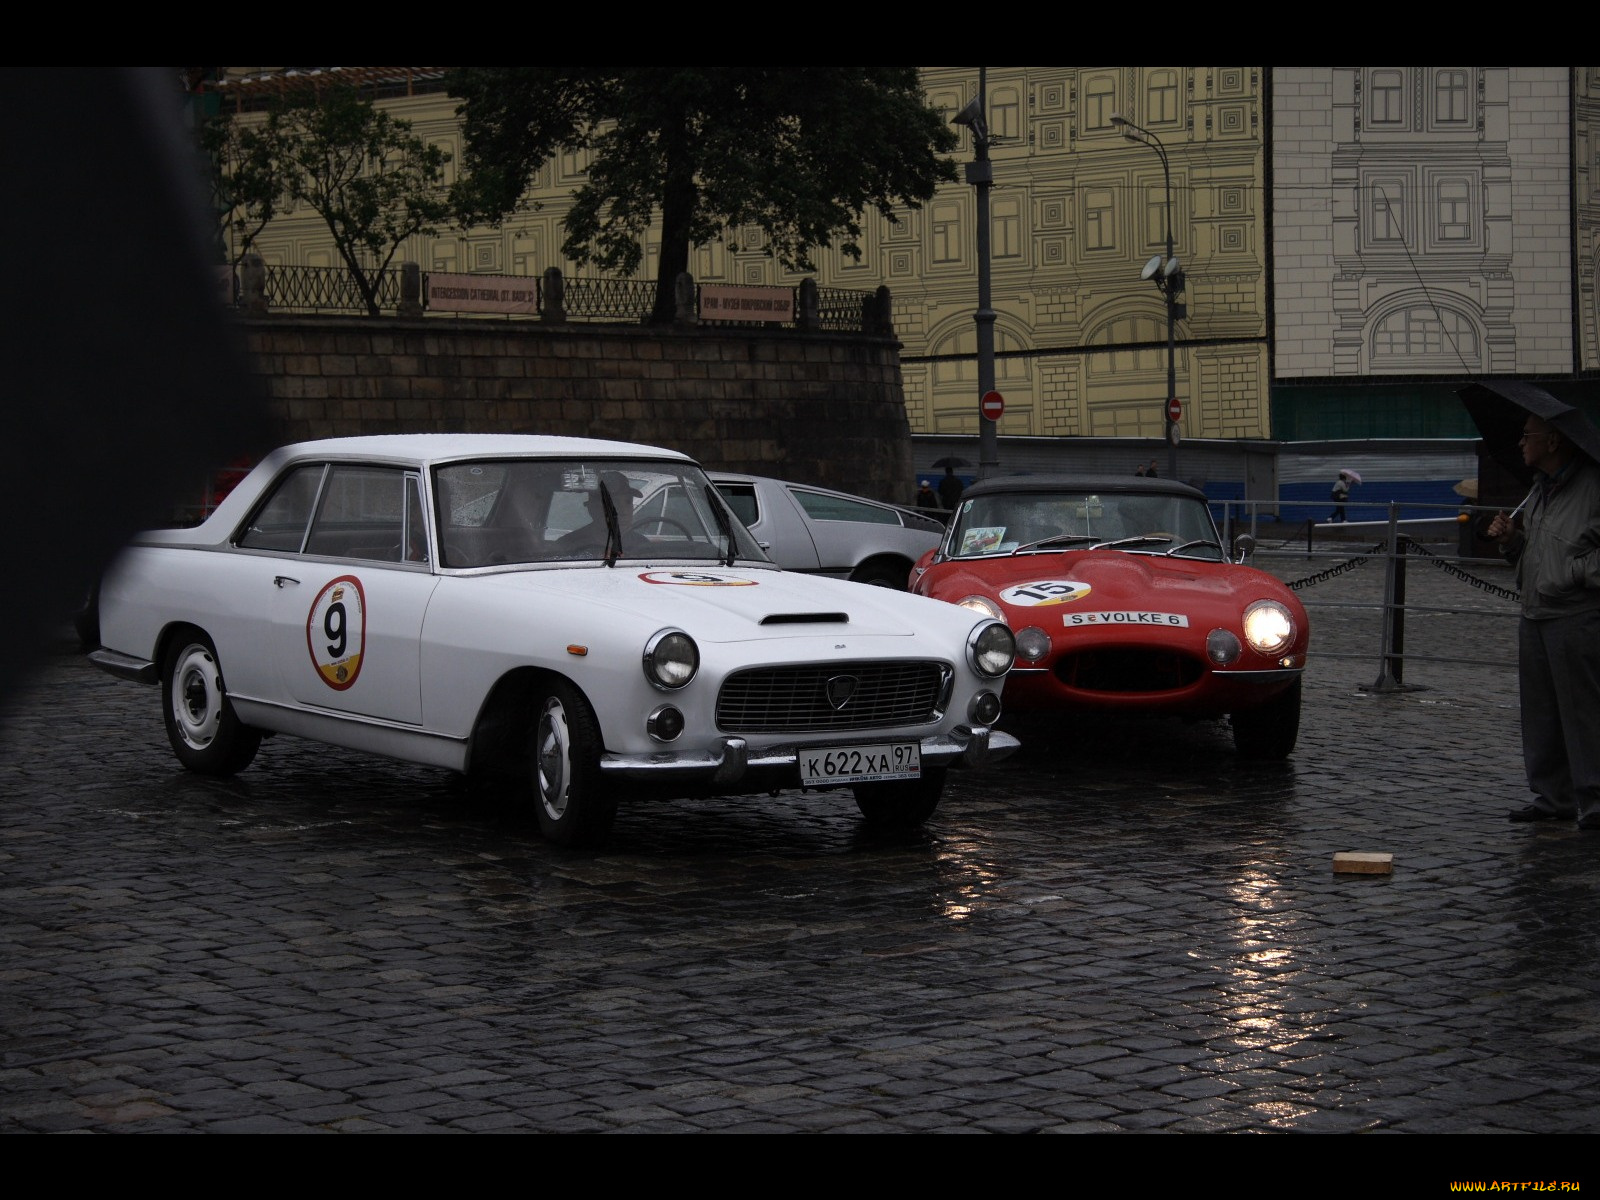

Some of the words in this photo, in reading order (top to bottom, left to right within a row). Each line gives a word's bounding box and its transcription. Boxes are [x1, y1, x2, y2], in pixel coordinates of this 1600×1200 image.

[470, 288, 500, 302] CATHEDRAL
[1012, 582, 1075, 600] 15
[1071, 614, 1083, 624] S
[1100, 612, 1163, 623] VOLKE
[1168, 615, 1180, 625] 6
[324, 602, 347, 658] 9
[895, 746, 912, 764] 97
[895, 764, 909, 772] RUS
